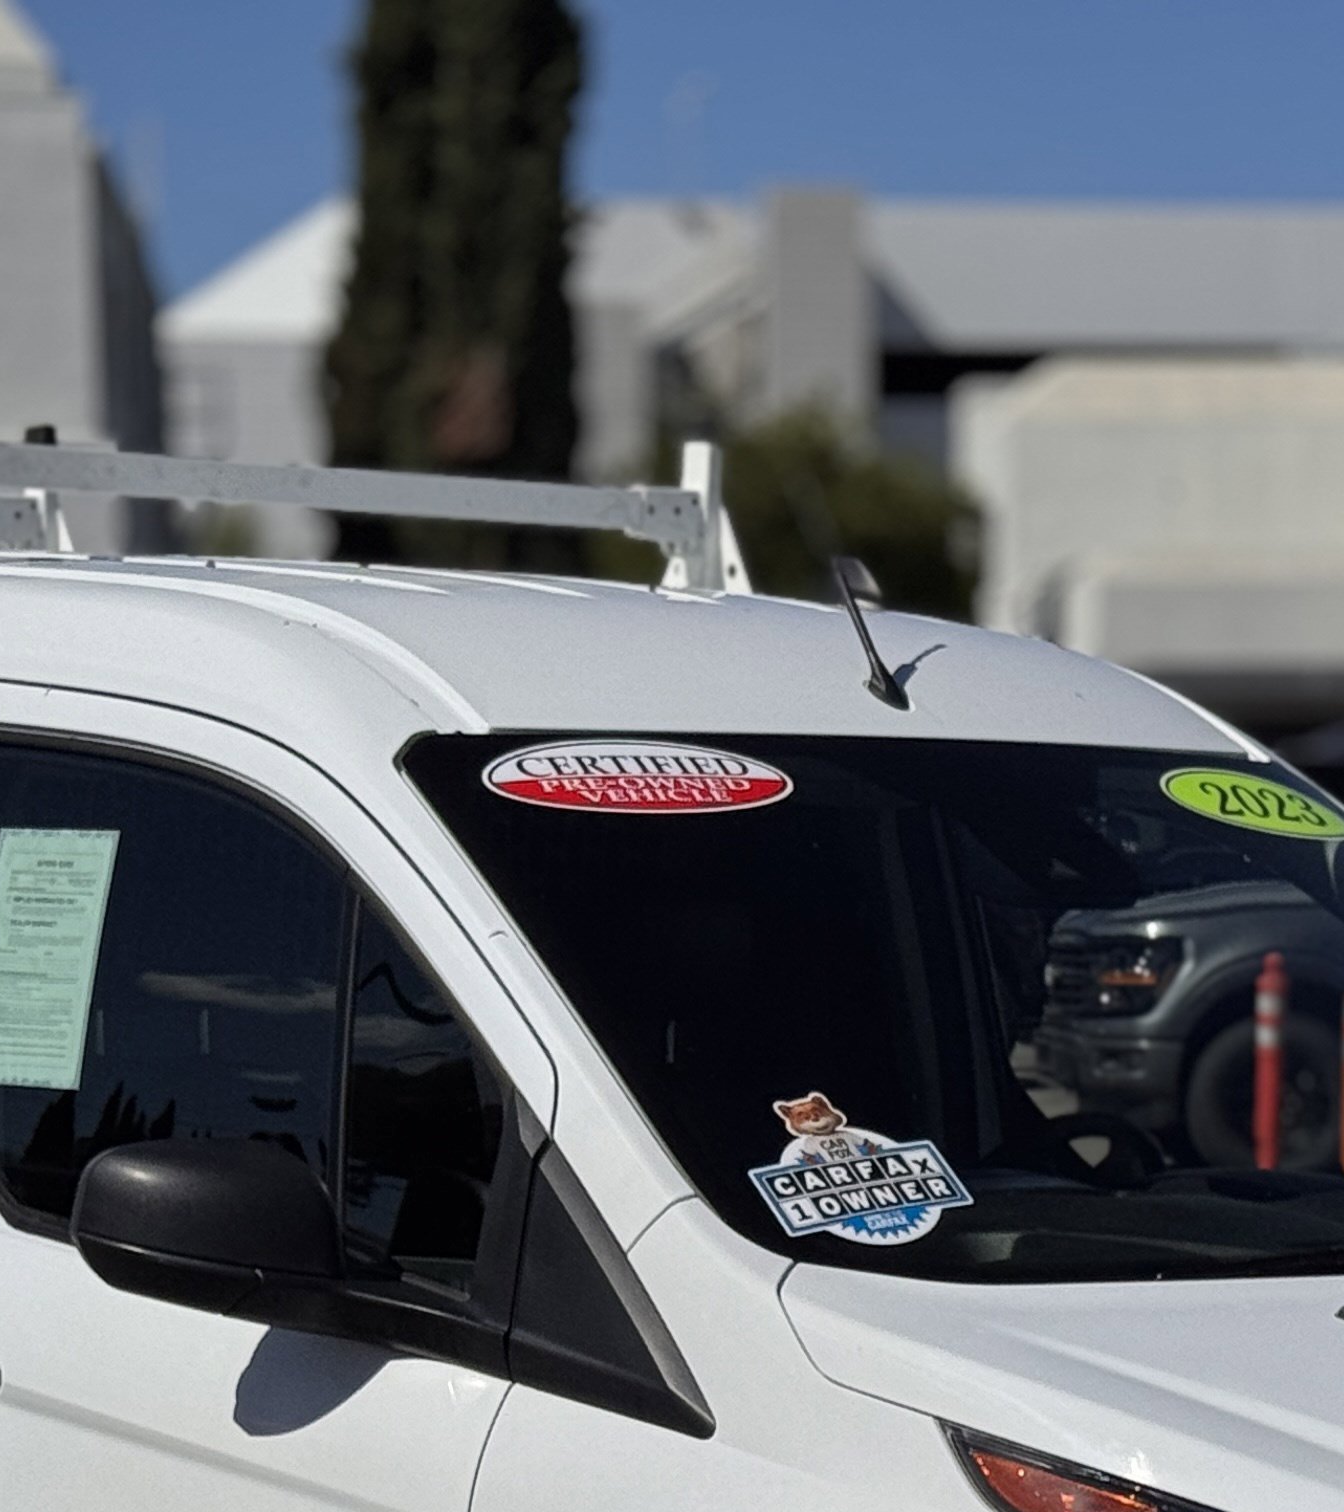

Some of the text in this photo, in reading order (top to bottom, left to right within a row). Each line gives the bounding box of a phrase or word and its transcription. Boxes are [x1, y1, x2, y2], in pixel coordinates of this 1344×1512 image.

[515, 755, 749, 778] CERTIFIED
[537, 777, 752, 793] PRE-OWNED
[576, 789, 734, 803] VEHICLE
[1198, 781, 1328, 827] 2023
[773, 1156, 936, 1196] CARFAX
[790, 1202, 814, 1222] 1
[817, 1177, 953, 1217] OWNER
